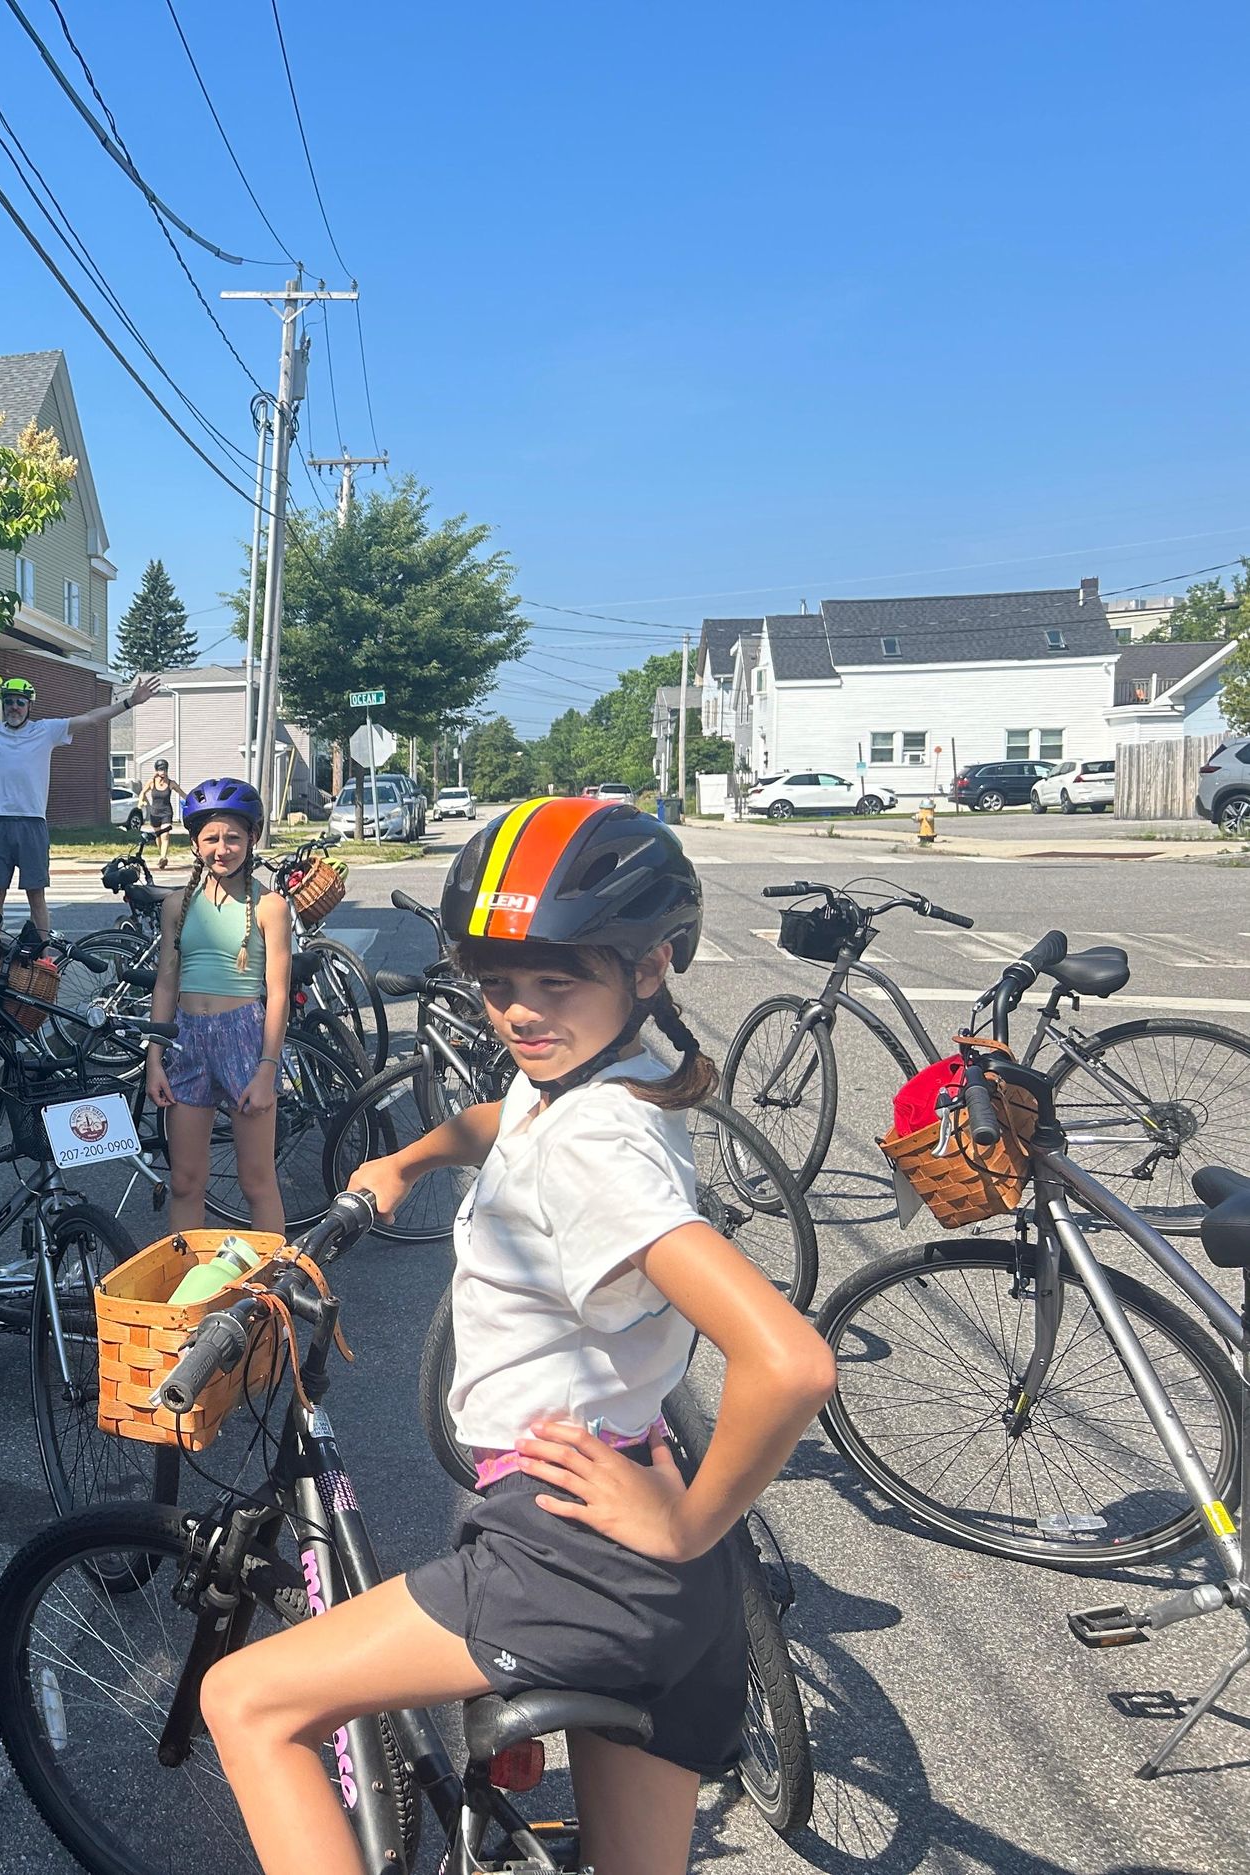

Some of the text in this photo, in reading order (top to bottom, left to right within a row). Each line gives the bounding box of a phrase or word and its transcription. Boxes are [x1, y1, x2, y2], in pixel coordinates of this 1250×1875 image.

[352, 693, 376, 705] OCEAN
[488, 894, 525, 909] LEM
[60, 1138, 135, 1162] 207-200-0900
